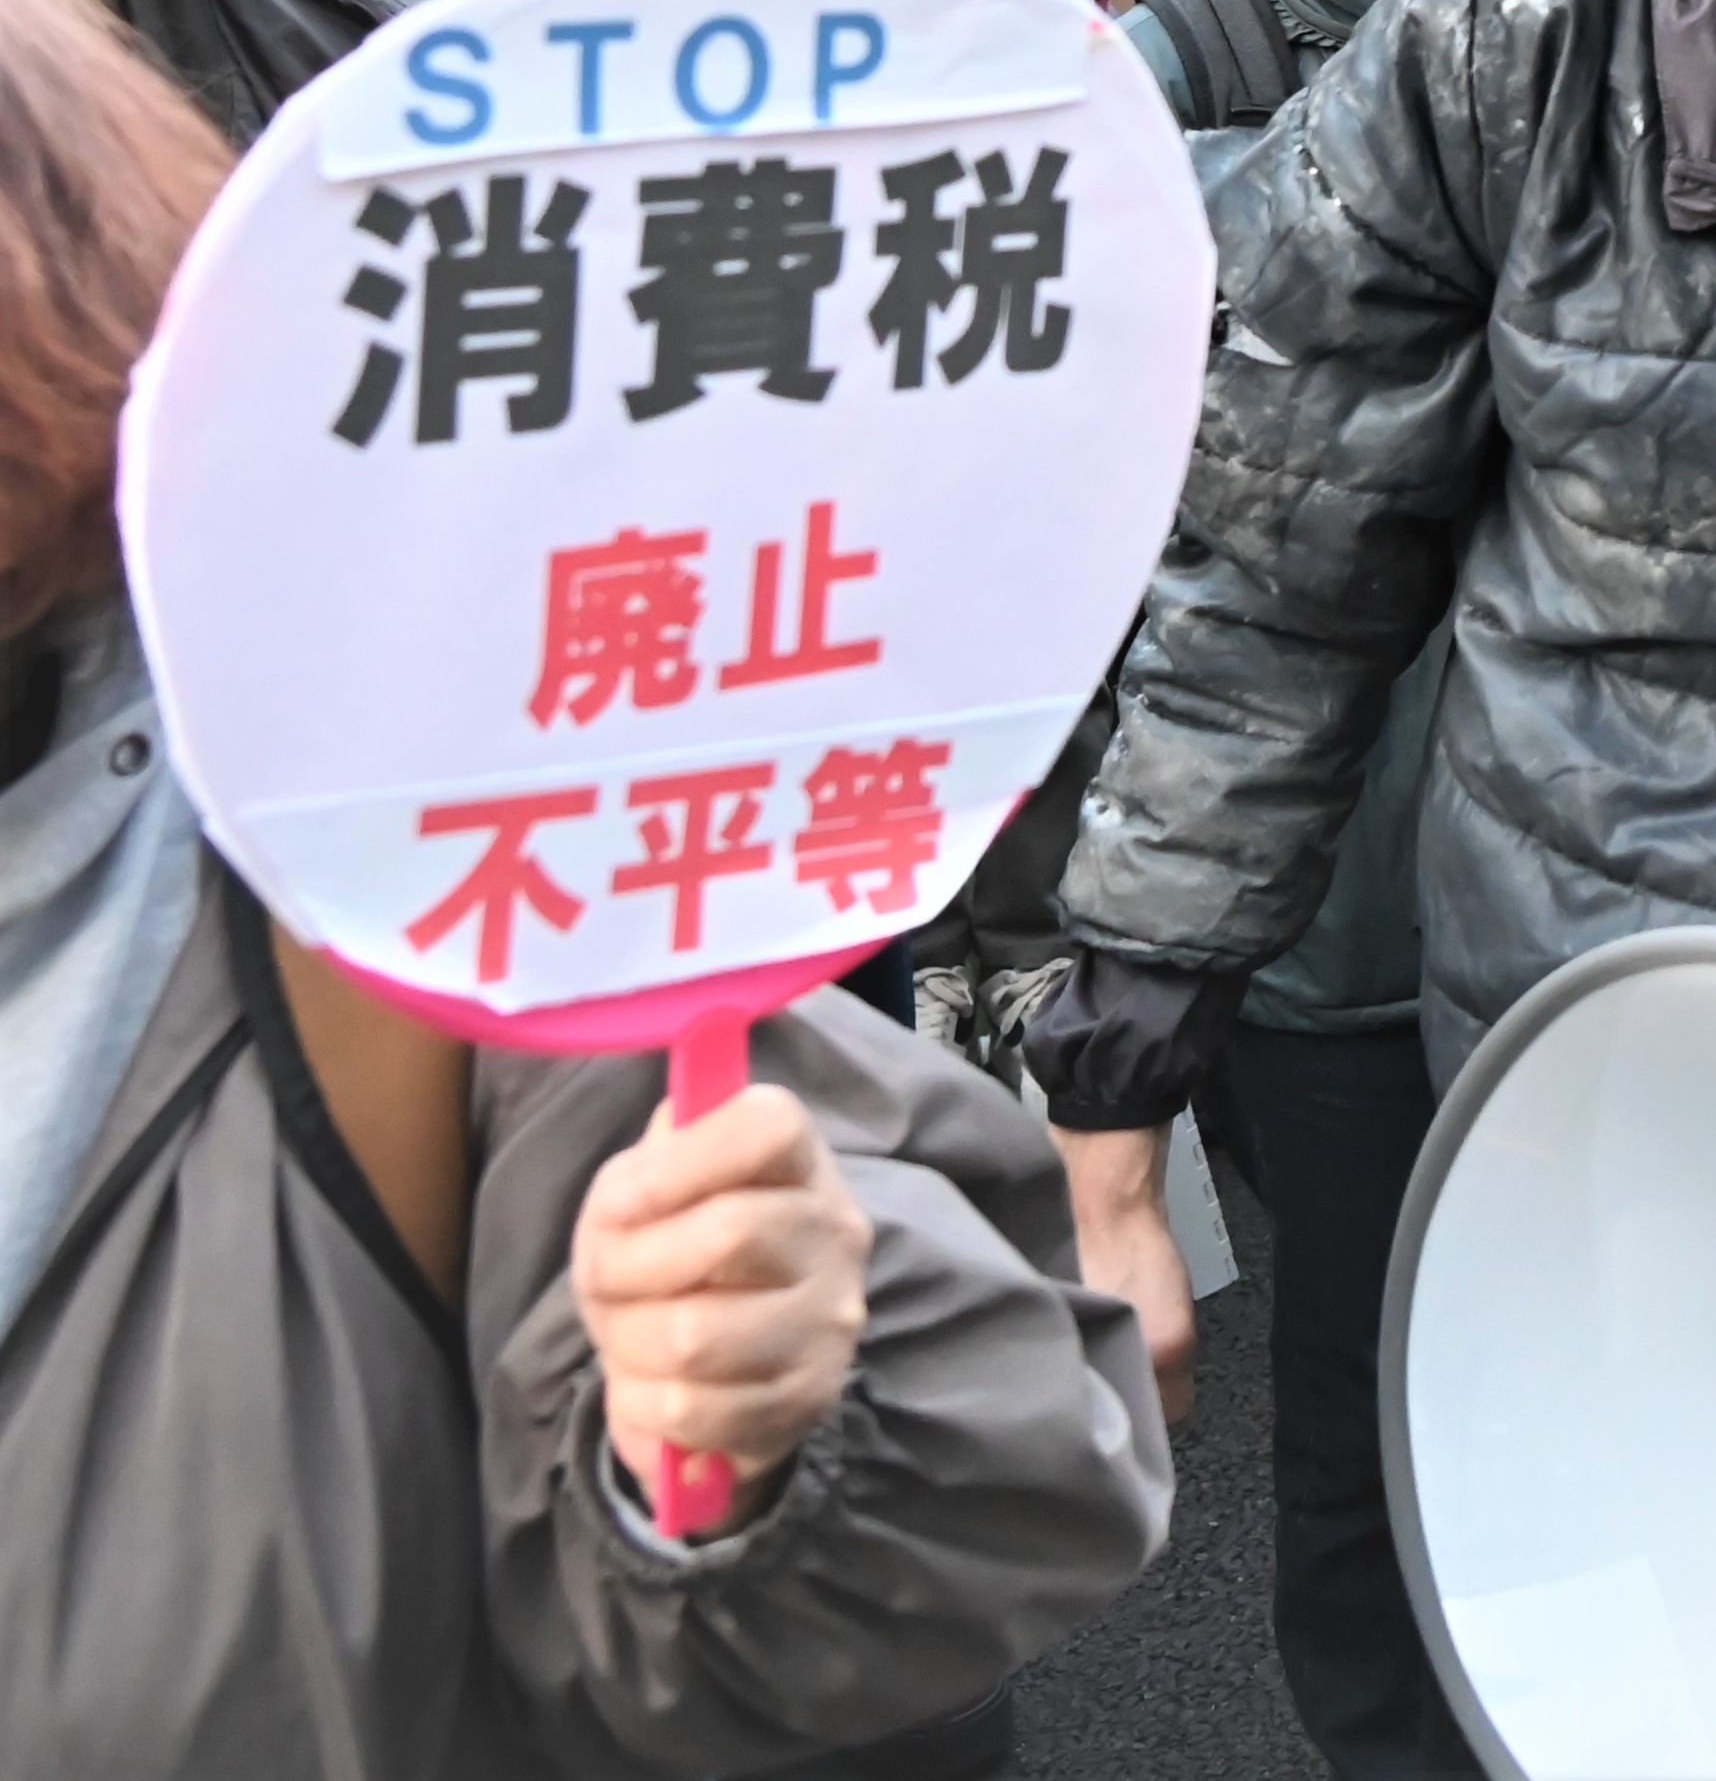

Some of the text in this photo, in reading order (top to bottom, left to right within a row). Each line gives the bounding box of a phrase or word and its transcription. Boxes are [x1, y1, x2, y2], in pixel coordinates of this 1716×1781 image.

[403, 9, 890, 149] STOP
[329, 145, 1077, 452] 消費税
[525, 499, 884, 731] 廃止
[402, 736, 956, 986] 不平等
